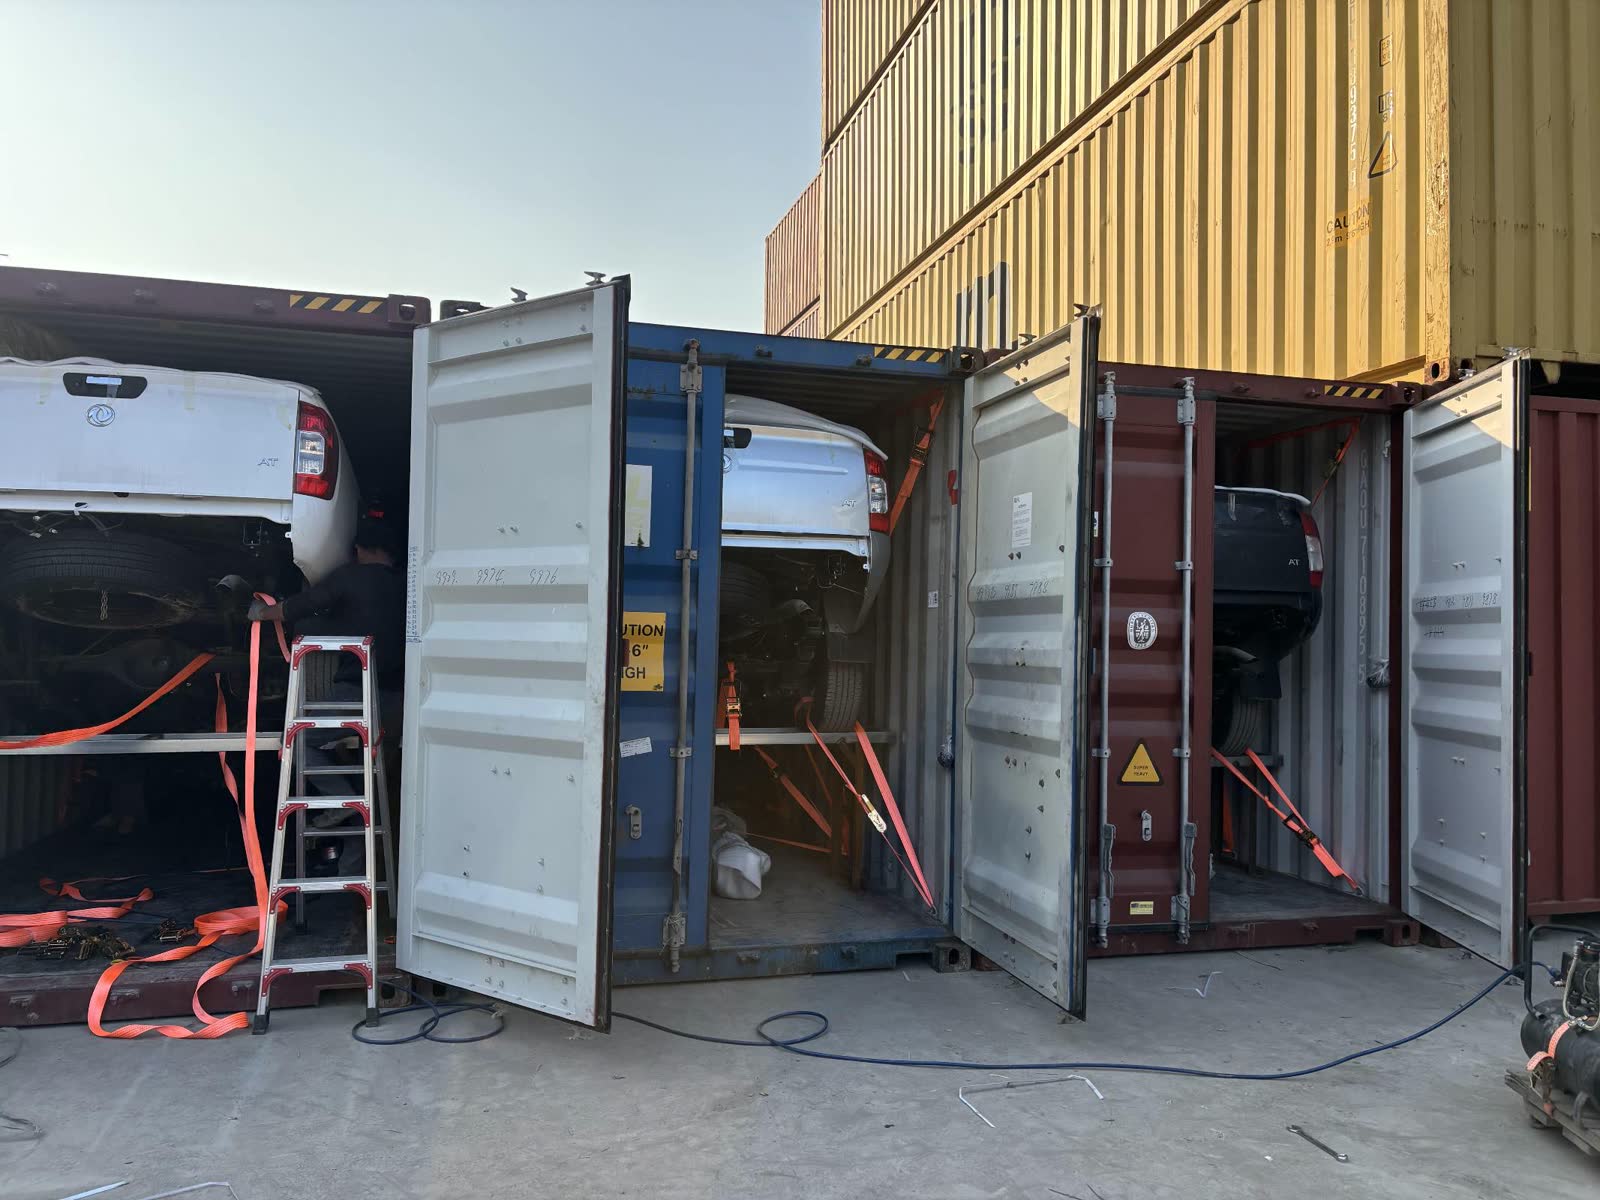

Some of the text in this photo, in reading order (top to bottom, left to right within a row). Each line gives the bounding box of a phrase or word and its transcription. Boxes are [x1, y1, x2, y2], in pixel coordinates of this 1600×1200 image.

[258, 458, 278, 467] AT
[842, 500, 856, 508] AT
[1288, 558, 1300, 566] AT
[621, 624, 664, 637] UTION
[621, 667, 646, 679] IGH
